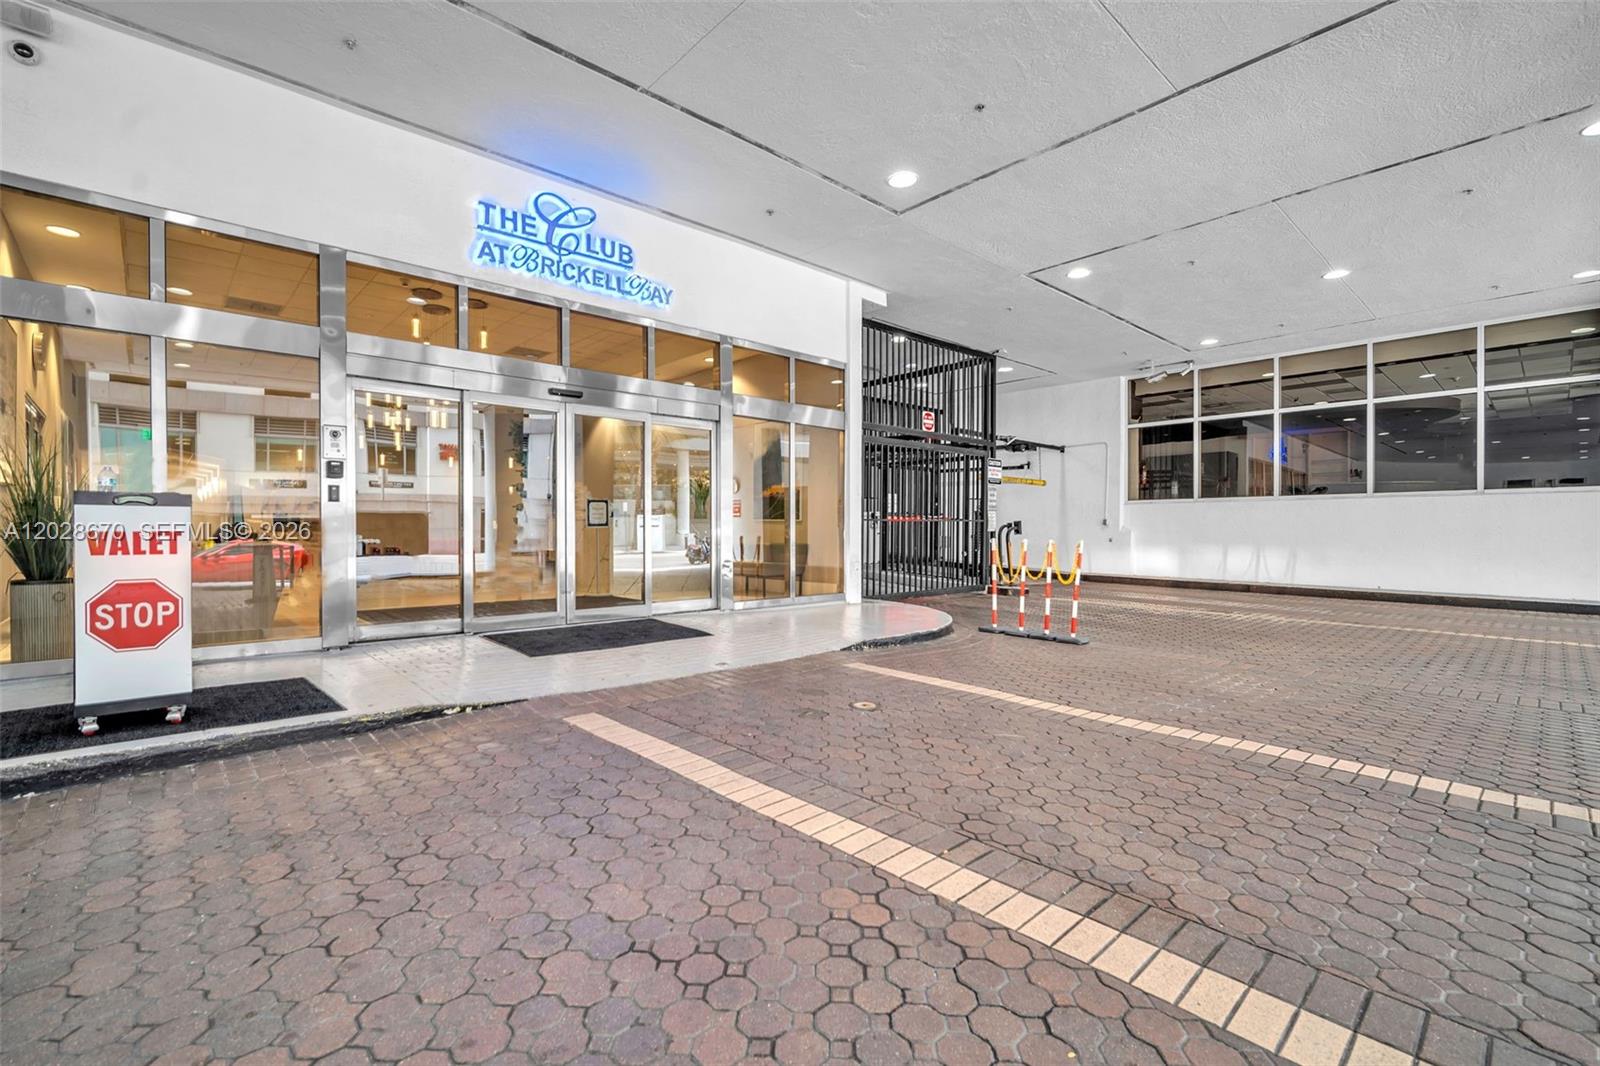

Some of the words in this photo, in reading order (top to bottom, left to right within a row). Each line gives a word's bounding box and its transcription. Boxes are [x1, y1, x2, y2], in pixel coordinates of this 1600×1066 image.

[478, 200, 538, 237] THE
[533, 192, 633, 265] CLUB
[477, 241, 509, 264] AT
[509, 244, 631, 296] BRICKELL
[625, 273, 674, 305] BAY
[86, 530, 184, 556] VALET
[94, 600, 176, 631] STOP
